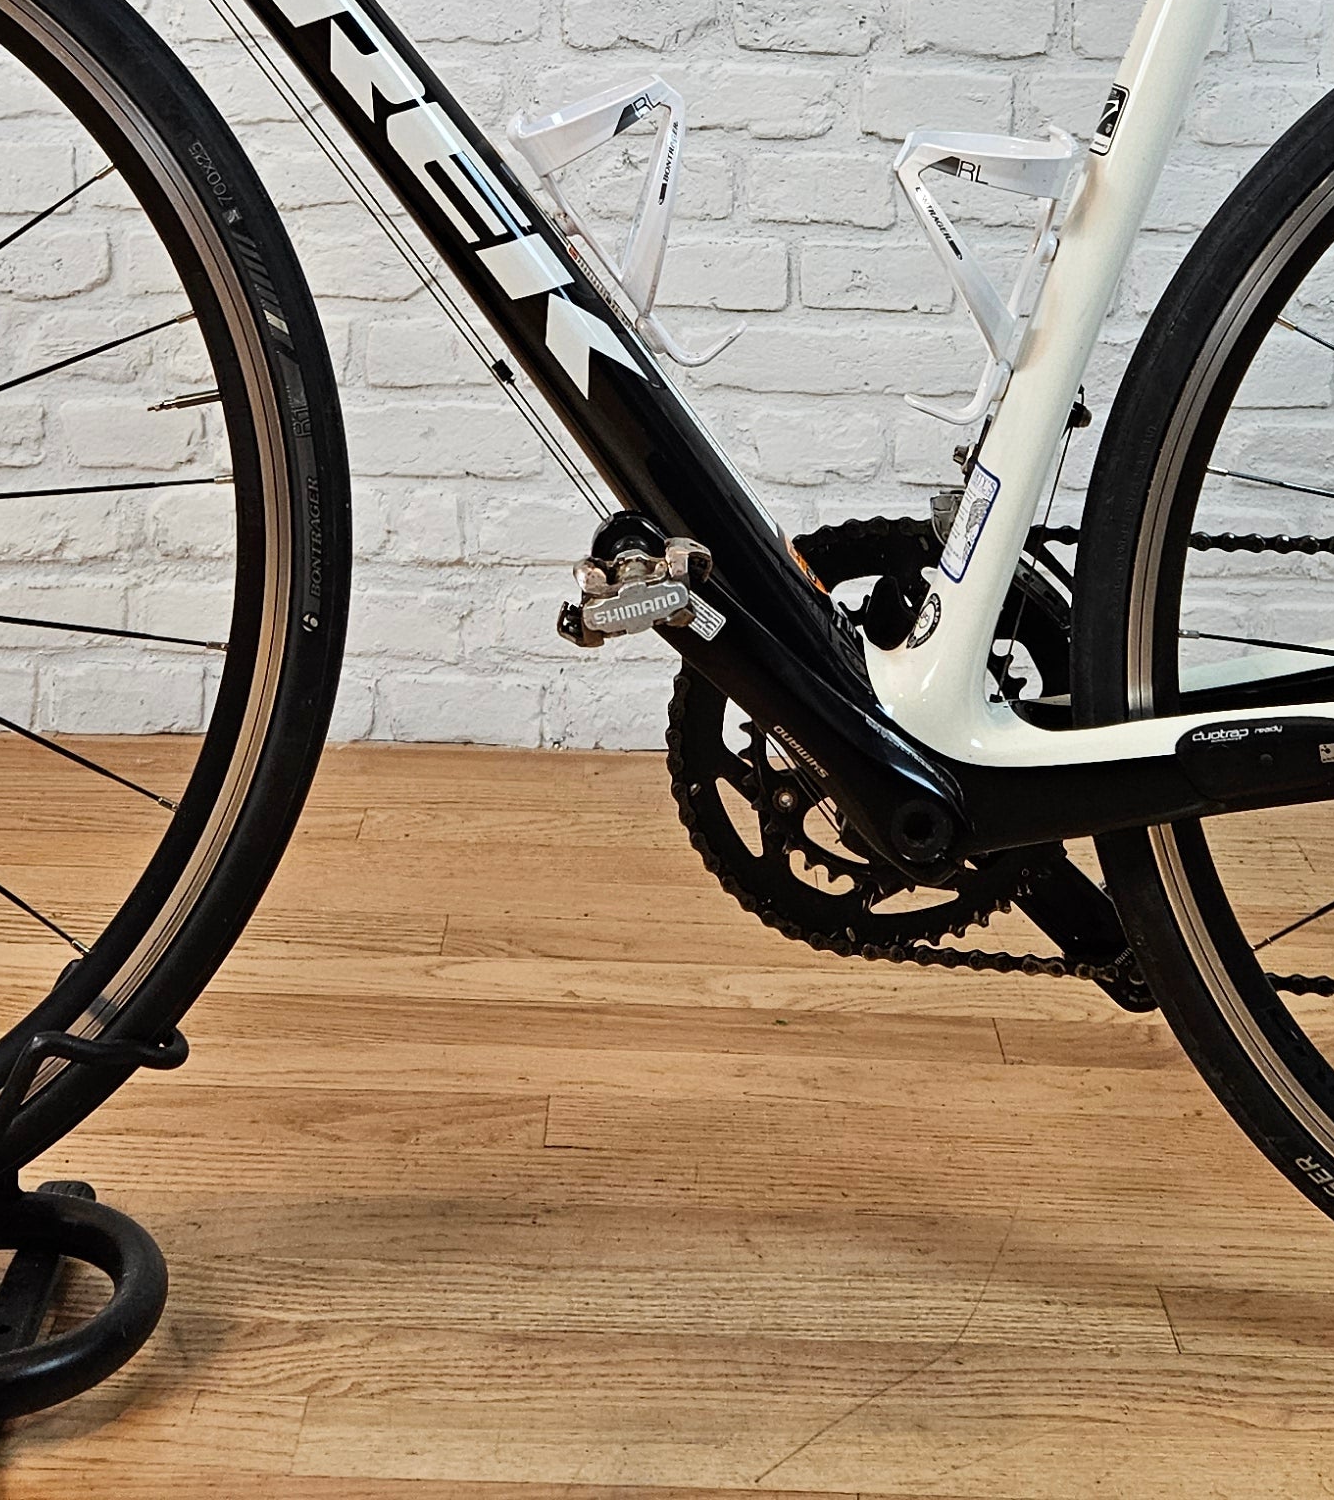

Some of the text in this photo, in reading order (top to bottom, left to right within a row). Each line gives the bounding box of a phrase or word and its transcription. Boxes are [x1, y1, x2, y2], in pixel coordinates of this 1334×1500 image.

[633, 92, 661, 111] RL
[187, 139, 233, 206] 700x25
[957, 160, 988, 185] RL
[306, 476, 324, 598] BONTRAGER
[593, 591, 680, 625] SHIMANO
[1192, 725, 1283, 742] duotrap ready
[773, 725, 829, 779] SHIMANO
